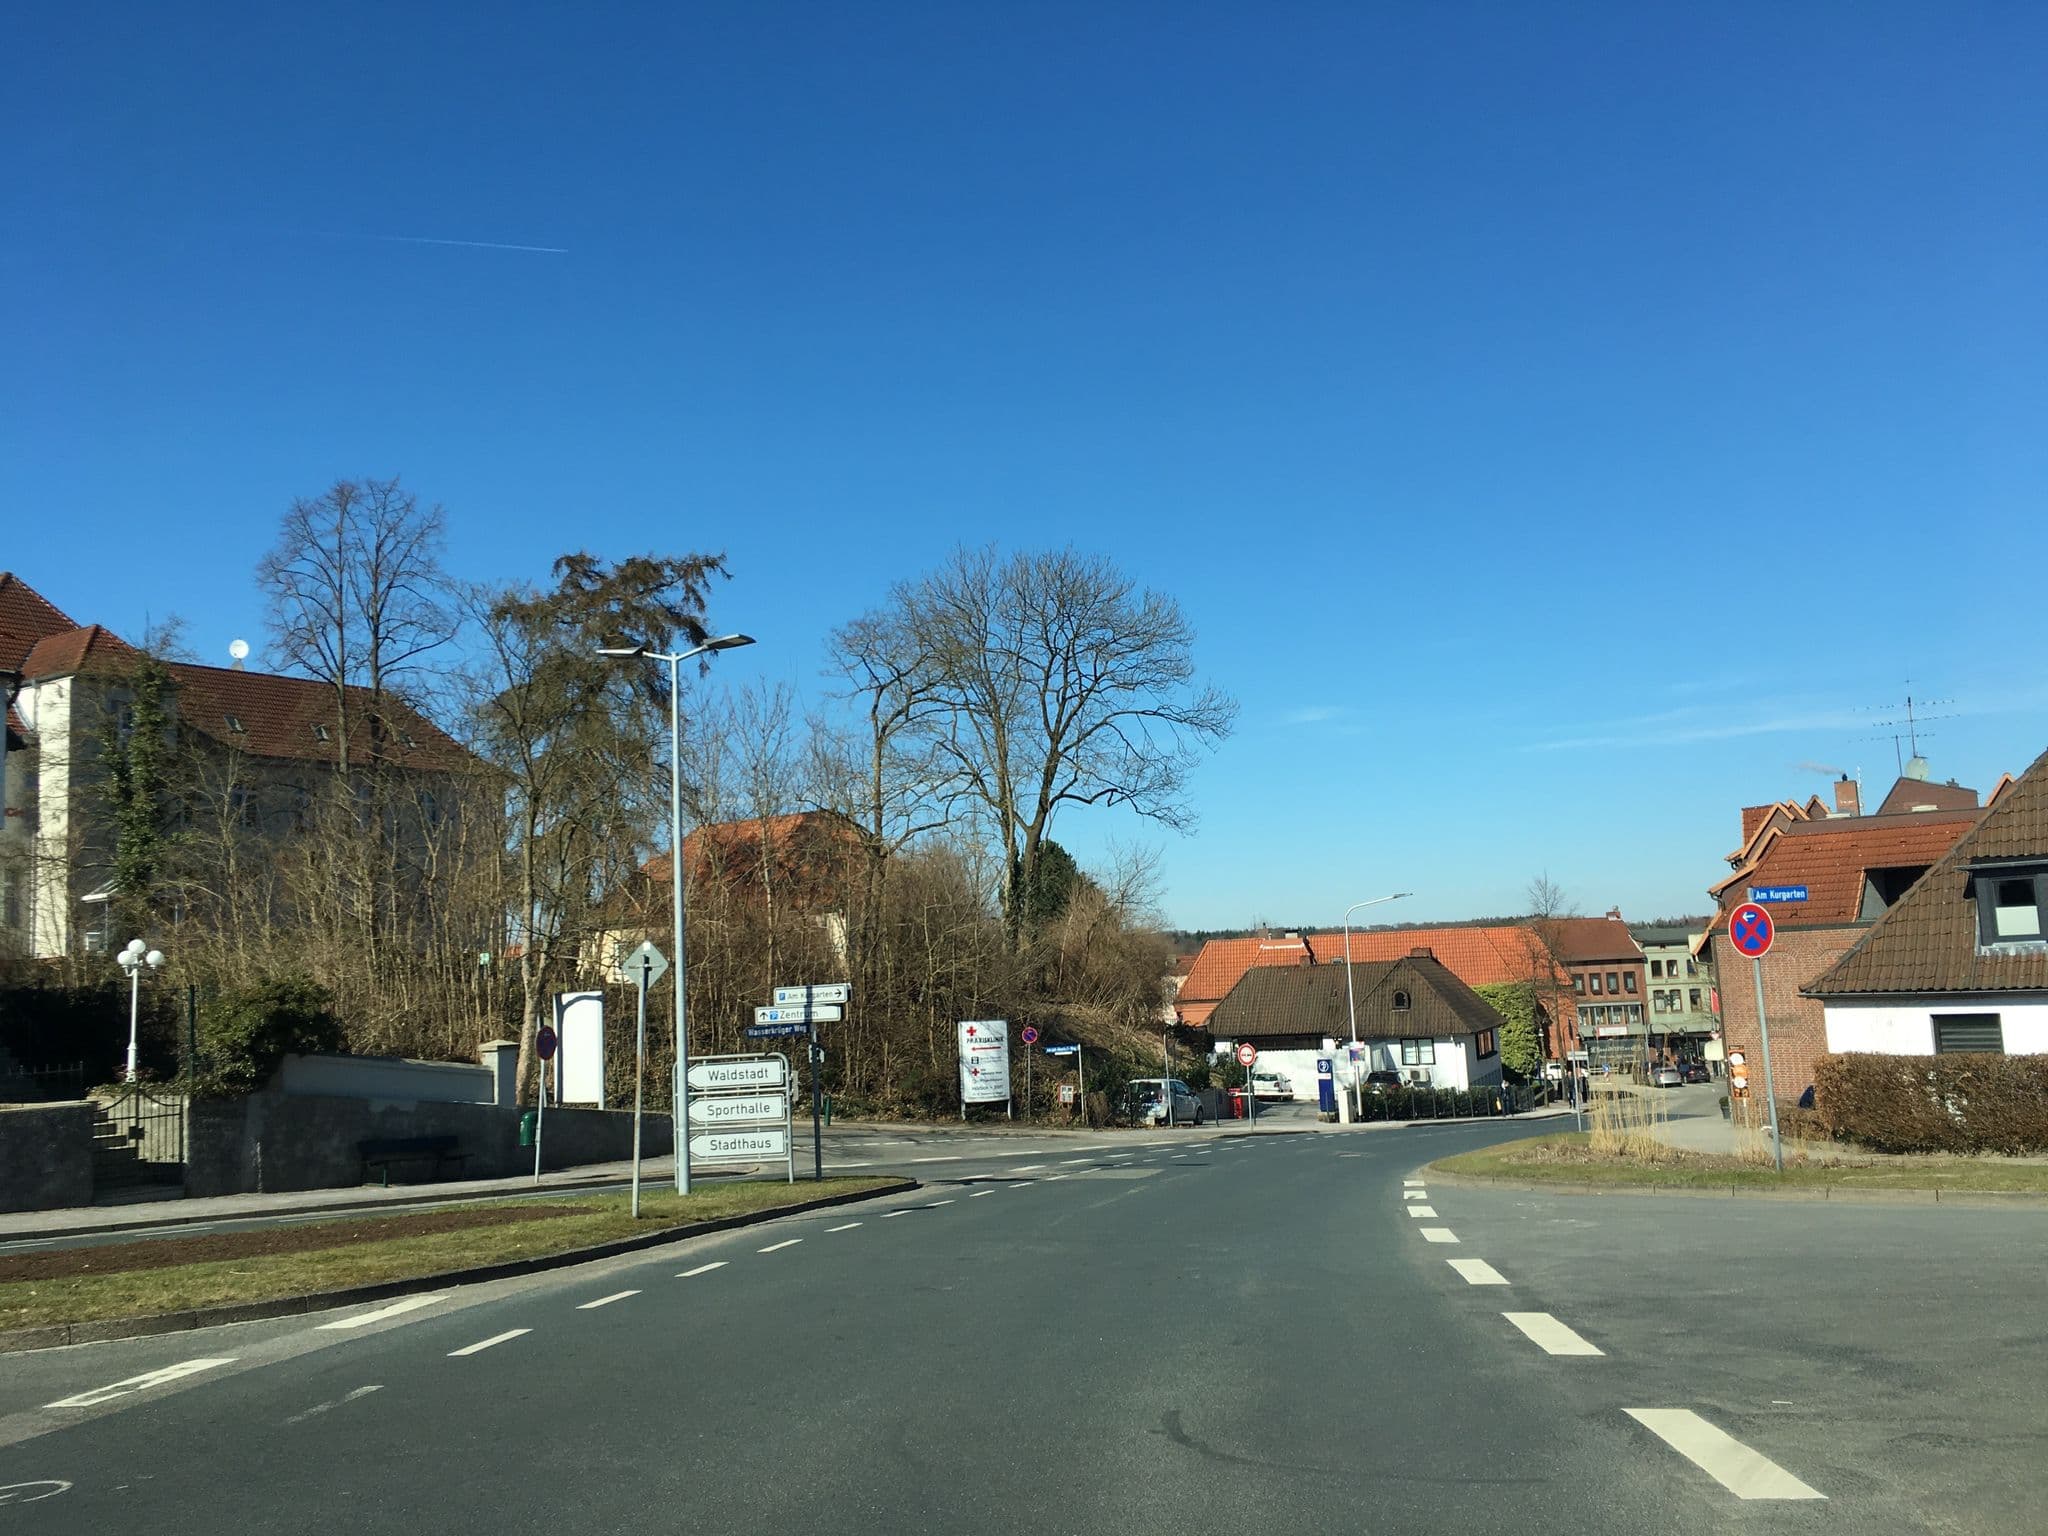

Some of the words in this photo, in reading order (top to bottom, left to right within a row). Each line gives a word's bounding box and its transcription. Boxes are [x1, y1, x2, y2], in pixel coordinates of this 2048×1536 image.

[1756, 890, 1767, 900] Am
[1770, 890, 1805, 901] Kurgarten
[780, 1010, 818, 1020] Zentrum
[708, 1068, 769, 1081] Waldstadt
[707, 1103, 770, 1118] Sporthalle
[710, 1139, 771, 1151] Stadthaus
